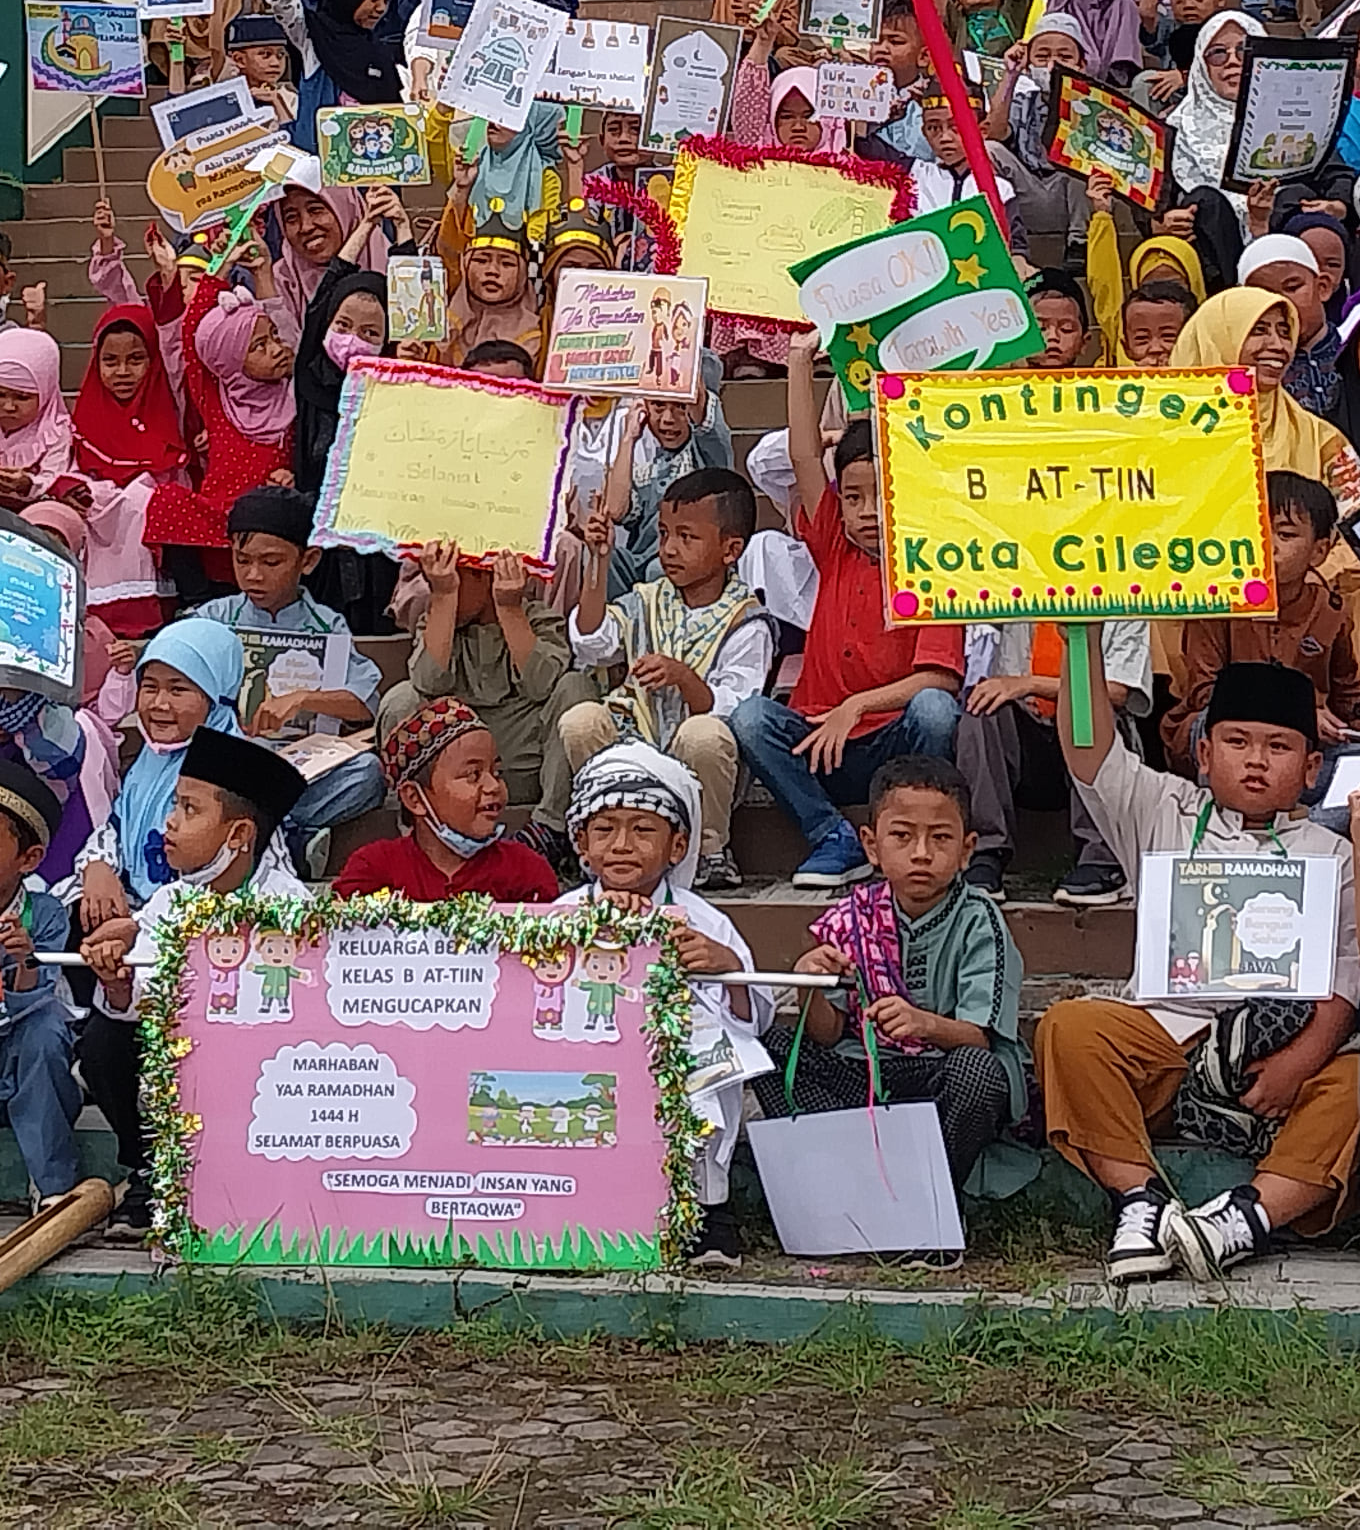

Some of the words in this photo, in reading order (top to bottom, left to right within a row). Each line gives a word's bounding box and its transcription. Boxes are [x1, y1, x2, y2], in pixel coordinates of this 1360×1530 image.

[813, 276, 887, 319] Puasa
[971, 296, 1025, 336] Yes!!
[966, 468, 988, 500] B
[1026, 465, 1156, 502] AT-TIIN
[904, 536, 1020, 574] Kota
[1052, 534, 1256, 573] Cilegon
[261, 635, 324, 650] RAMADHAN
[1224, 863, 1302, 878] RAMADHAN
[1247, 901, 1295, 918] Senang
[338, 939, 430, 956] KELUARGA
[341, 968, 394, 984] KELAS
[403, 968, 414, 983] B
[423, 967, 484, 983] AT-TIIN
[342, 997, 482, 1015] MENGUCAPKAN
[292, 1058, 380, 1072] MARHABAN
[275, 1083, 304, 1097] YAA
[307, 1083, 396, 1097] RAMADHAN
[310, 1109, 344, 1123] 1444
[348, 1109, 360, 1122] H
[254, 1134, 322, 1149] SELAMAT
[324, 1134, 401, 1149] BERPUASA
[404, 1174, 472, 1190] MENJADI
[480, 1175, 528, 1191] INSAN
[531, 1177, 573, 1193] YANG
